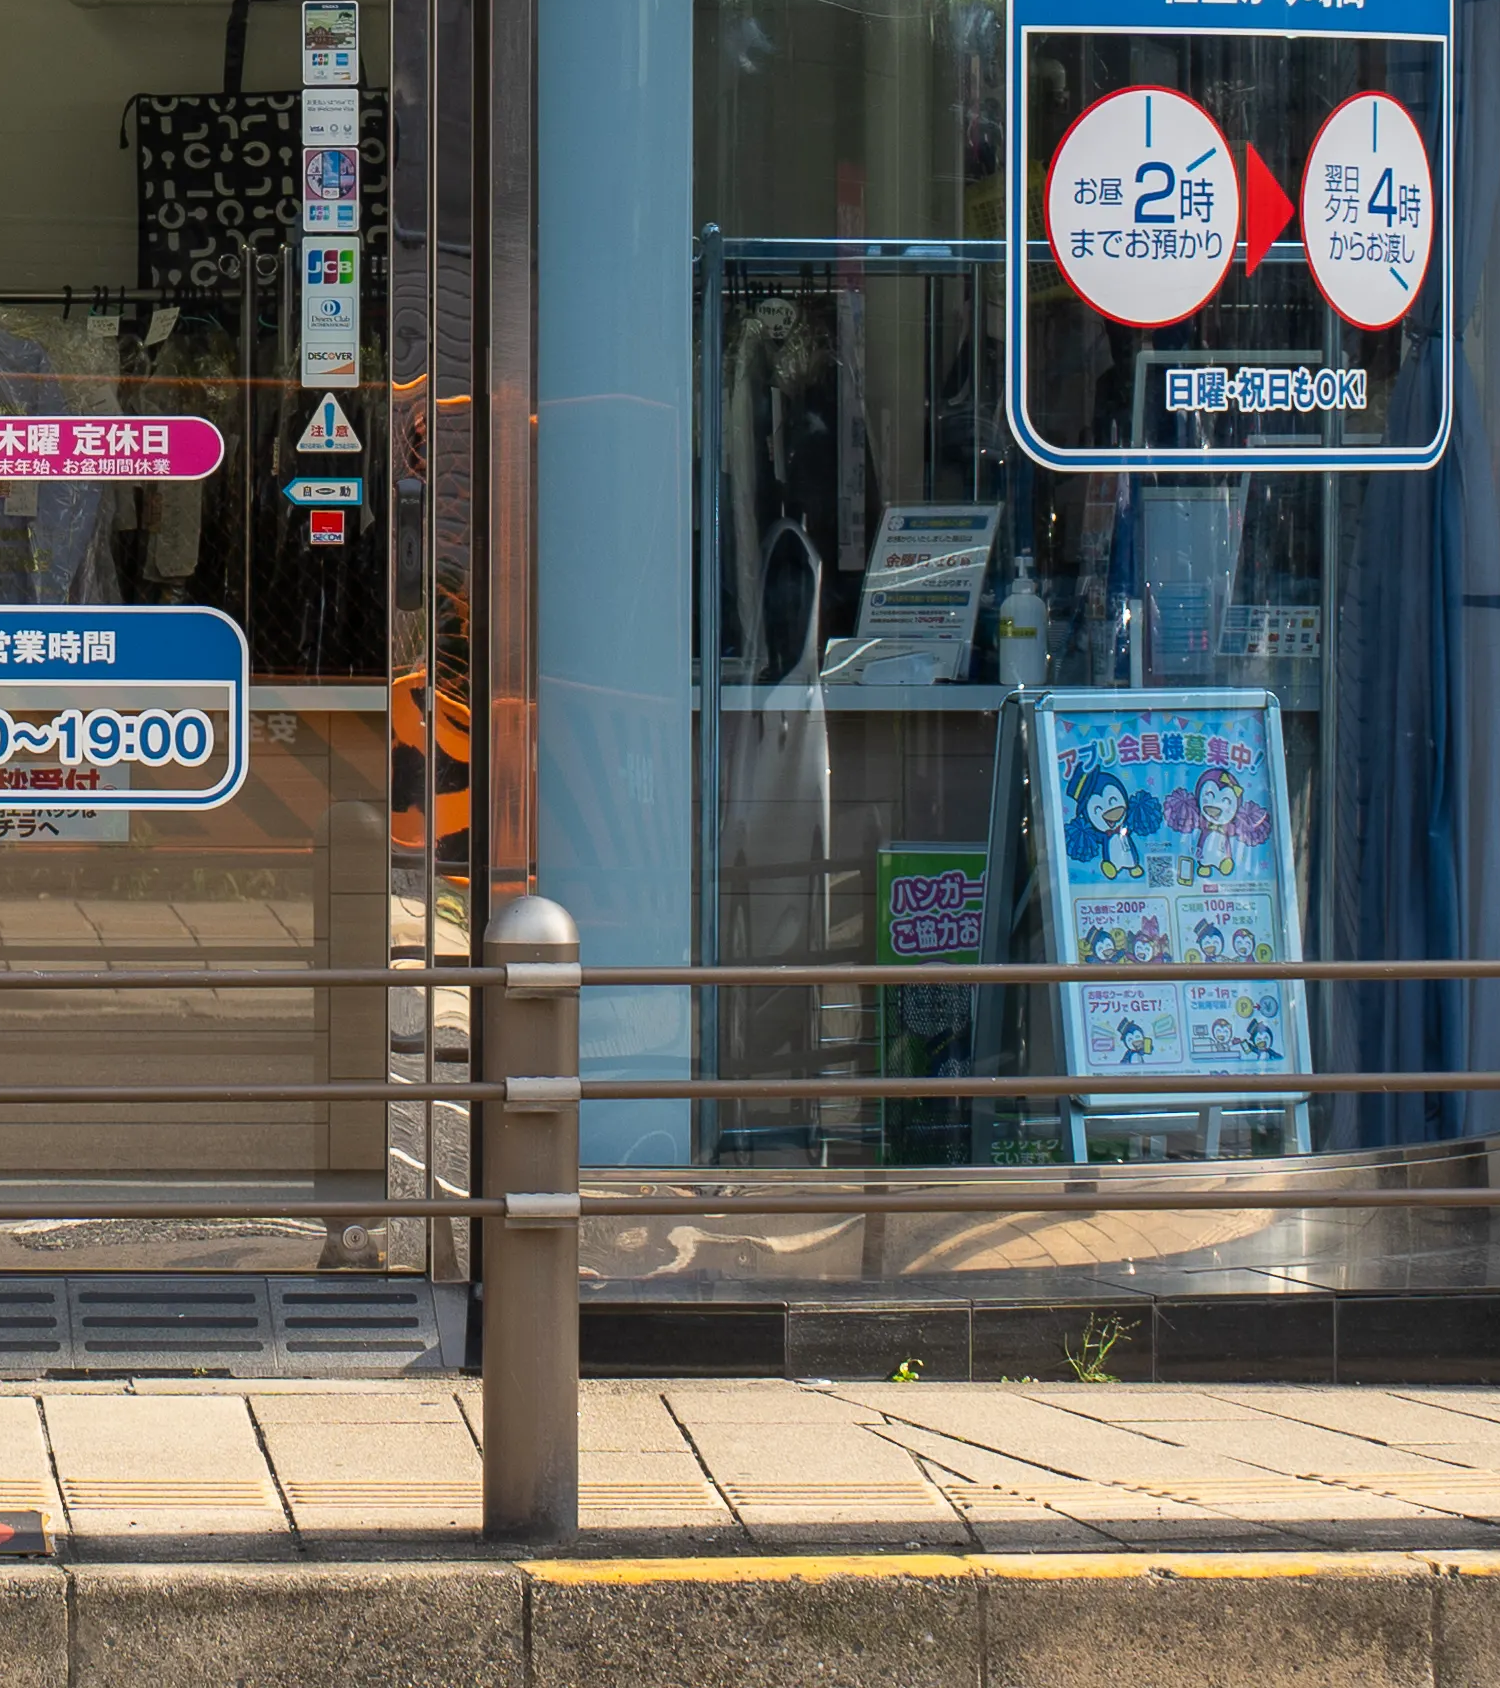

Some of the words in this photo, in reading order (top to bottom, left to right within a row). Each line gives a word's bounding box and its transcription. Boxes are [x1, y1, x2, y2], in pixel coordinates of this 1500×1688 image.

[1073, 178, 1123, 206] お昼
[1324, 164, 1360, 193] 翌日
[1325, 195, 1360, 224] 夕方
[1070, 229, 1223, 260] までお預かり
[1329, 231, 1415, 264] からお渡し
[72, 423, 170, 456] 定休日
